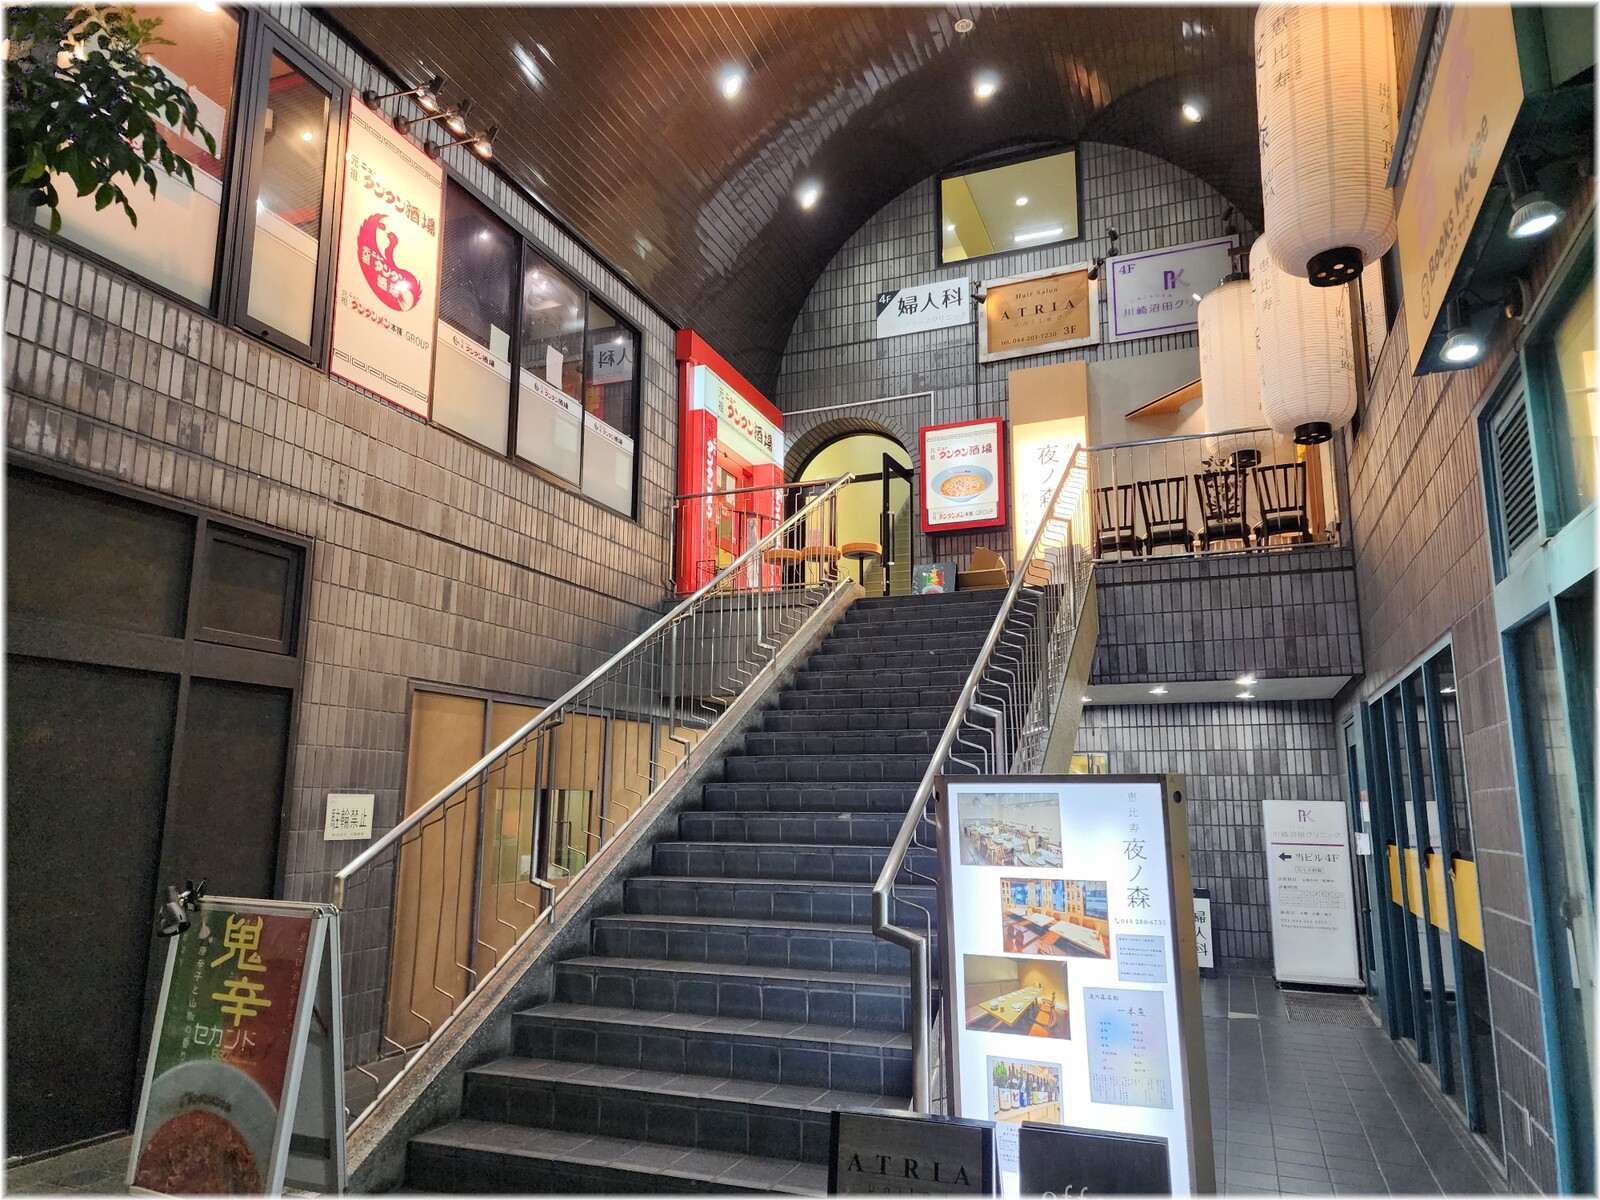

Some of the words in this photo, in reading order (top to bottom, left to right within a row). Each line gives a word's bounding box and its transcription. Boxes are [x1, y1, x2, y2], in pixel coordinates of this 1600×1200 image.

[1118, 263, 1136, 275] 4F
[878, 294, 892, 304] 4F
[897, 286, 963, 317] 婦人科
[1015, 291, 1033, 300] Hair
[1036, 287, 1058, 296] Salon
[1000, 299, 1075, 321] ATRIA
[1012, 332, 1057, 344] 044-201-7230
[1063, 325, 1077, 335] 3F
[405, 331, 430, 350] GROUP
[939, 442, 993, 460] タンタン酒場
[974, 508, 994, 517] GROUP
[331, 807, 368, 830] 駐輪禁止
[1127, 792, 1139, 834] 恵比寿
[1272, 831, 1341, 839] 川崎沼田クリニック
[1122, 837, 1152, 909] 夜ノ森
[1135, 918, 1168, 926] 280-6735
[193, 1022, 257, 1052] セカンド
[848, 1152, 971, 1186] ATRIA
